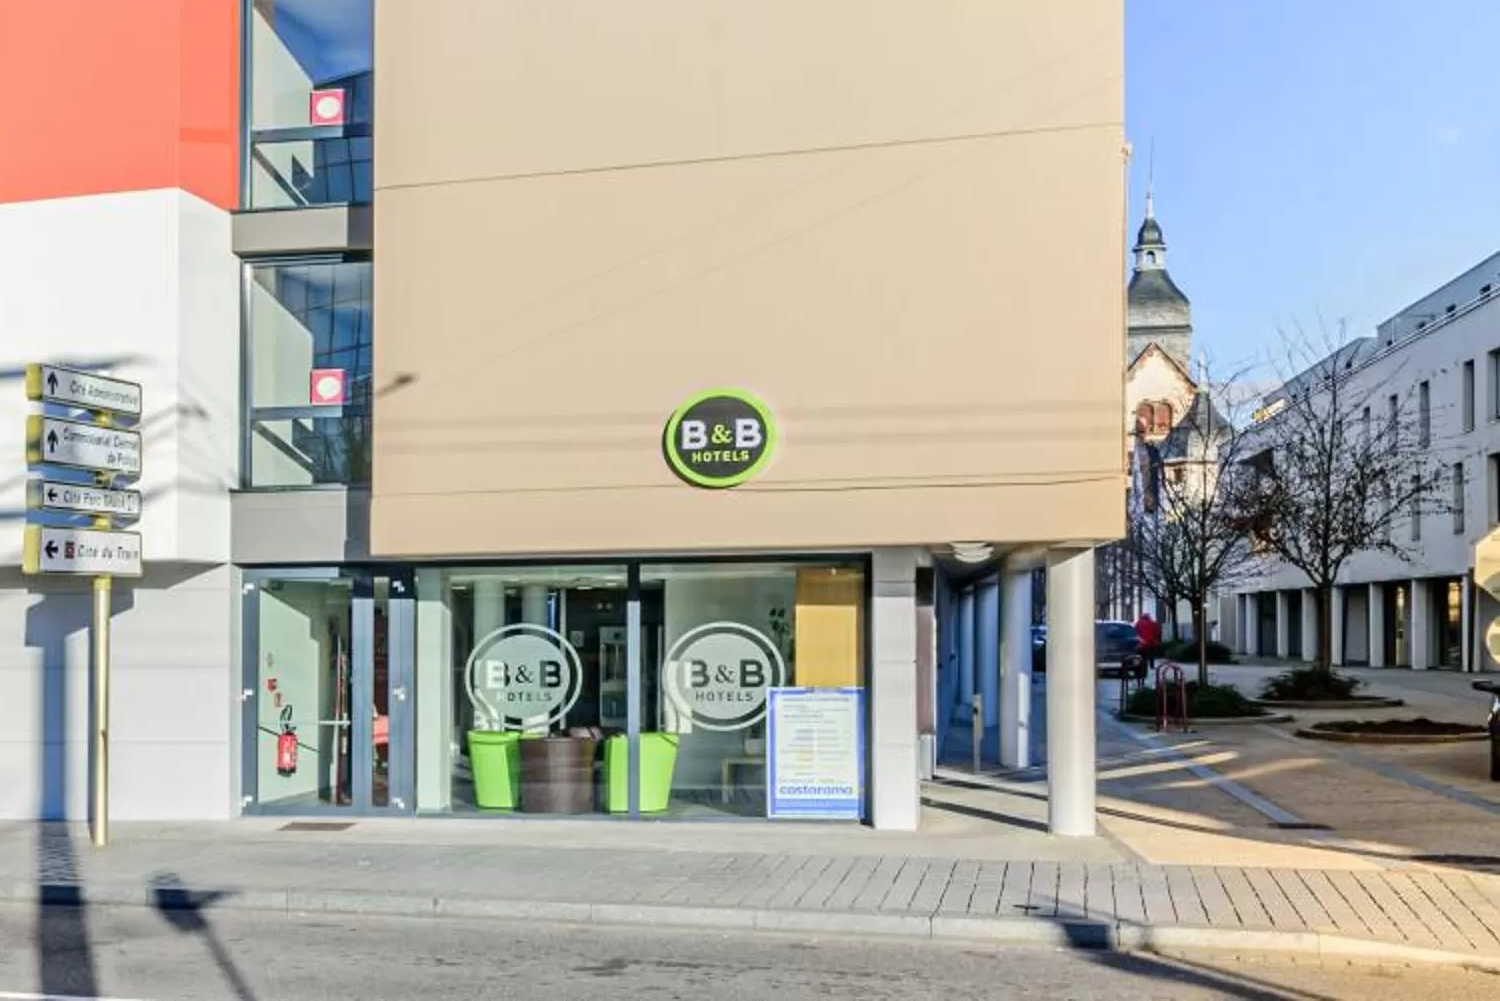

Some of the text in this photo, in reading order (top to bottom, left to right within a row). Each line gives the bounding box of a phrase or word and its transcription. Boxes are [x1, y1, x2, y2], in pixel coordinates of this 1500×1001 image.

[681, 418, 762, 450] B&B
[691, 450, 750, 464] HOTELS
[684, 659, 765, 688] B&B
[694, 690, 755, 702] HOTELS
